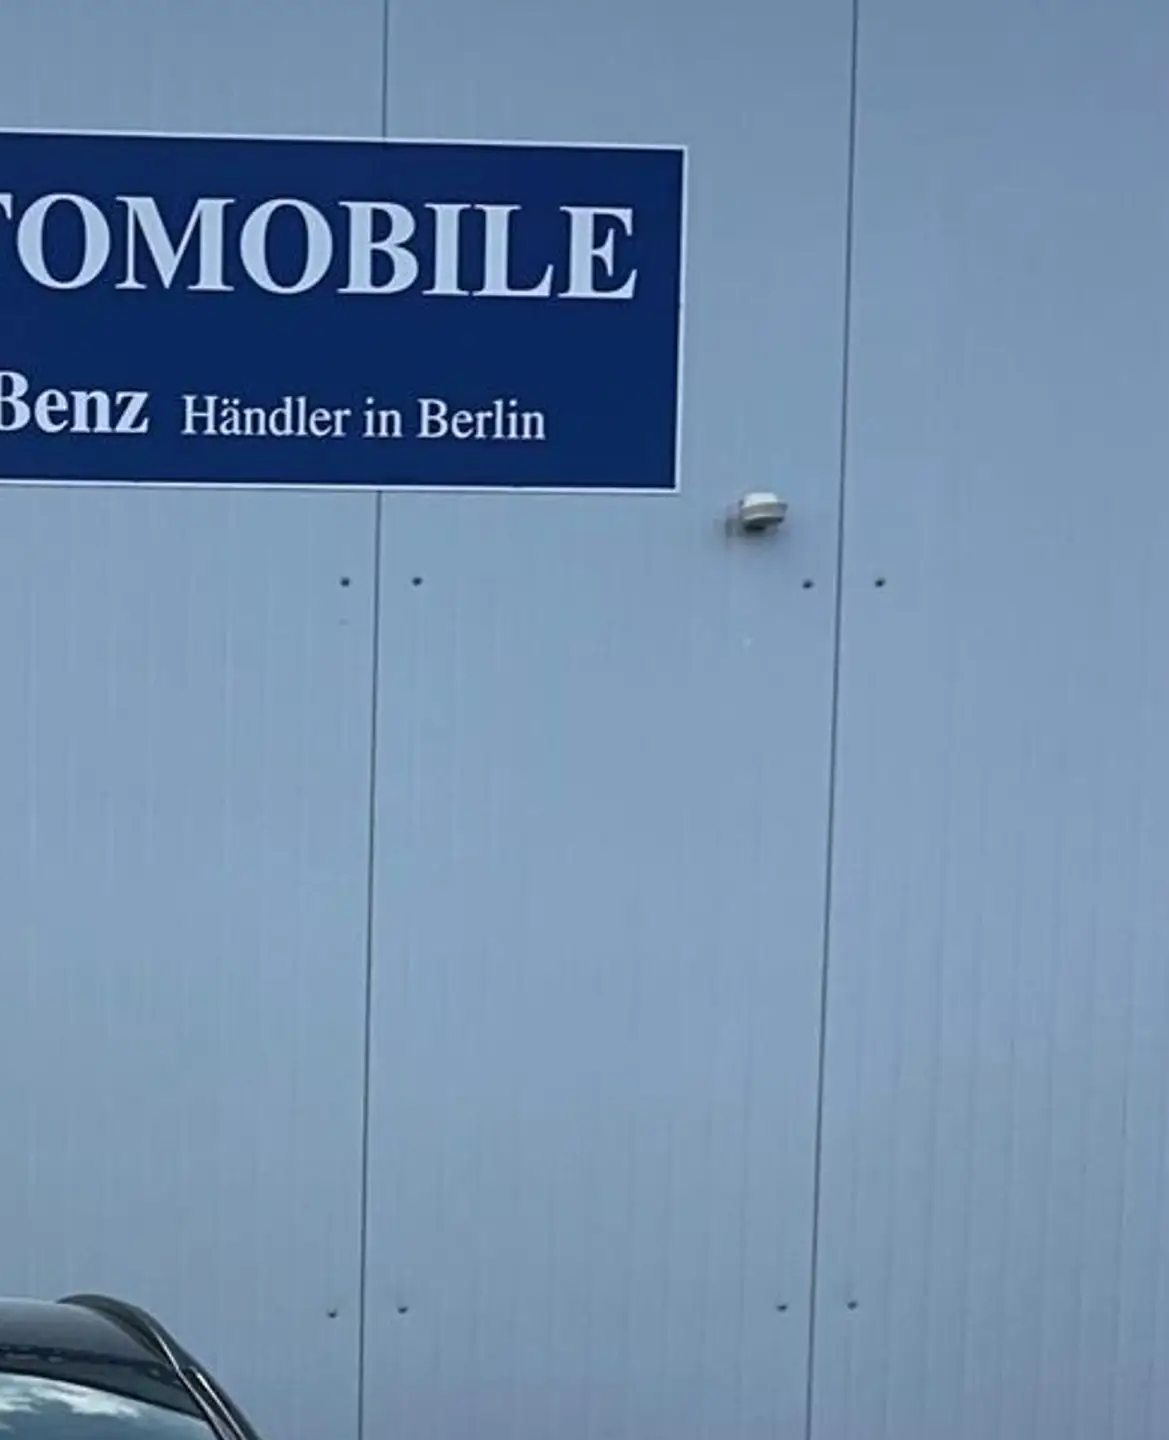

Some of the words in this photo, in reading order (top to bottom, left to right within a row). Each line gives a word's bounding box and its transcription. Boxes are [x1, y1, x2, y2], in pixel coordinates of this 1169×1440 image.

[182, 395, 352, 438] Händler
[365, 398, 403, 438] in
[418, 399, 546, 440] Berlin
